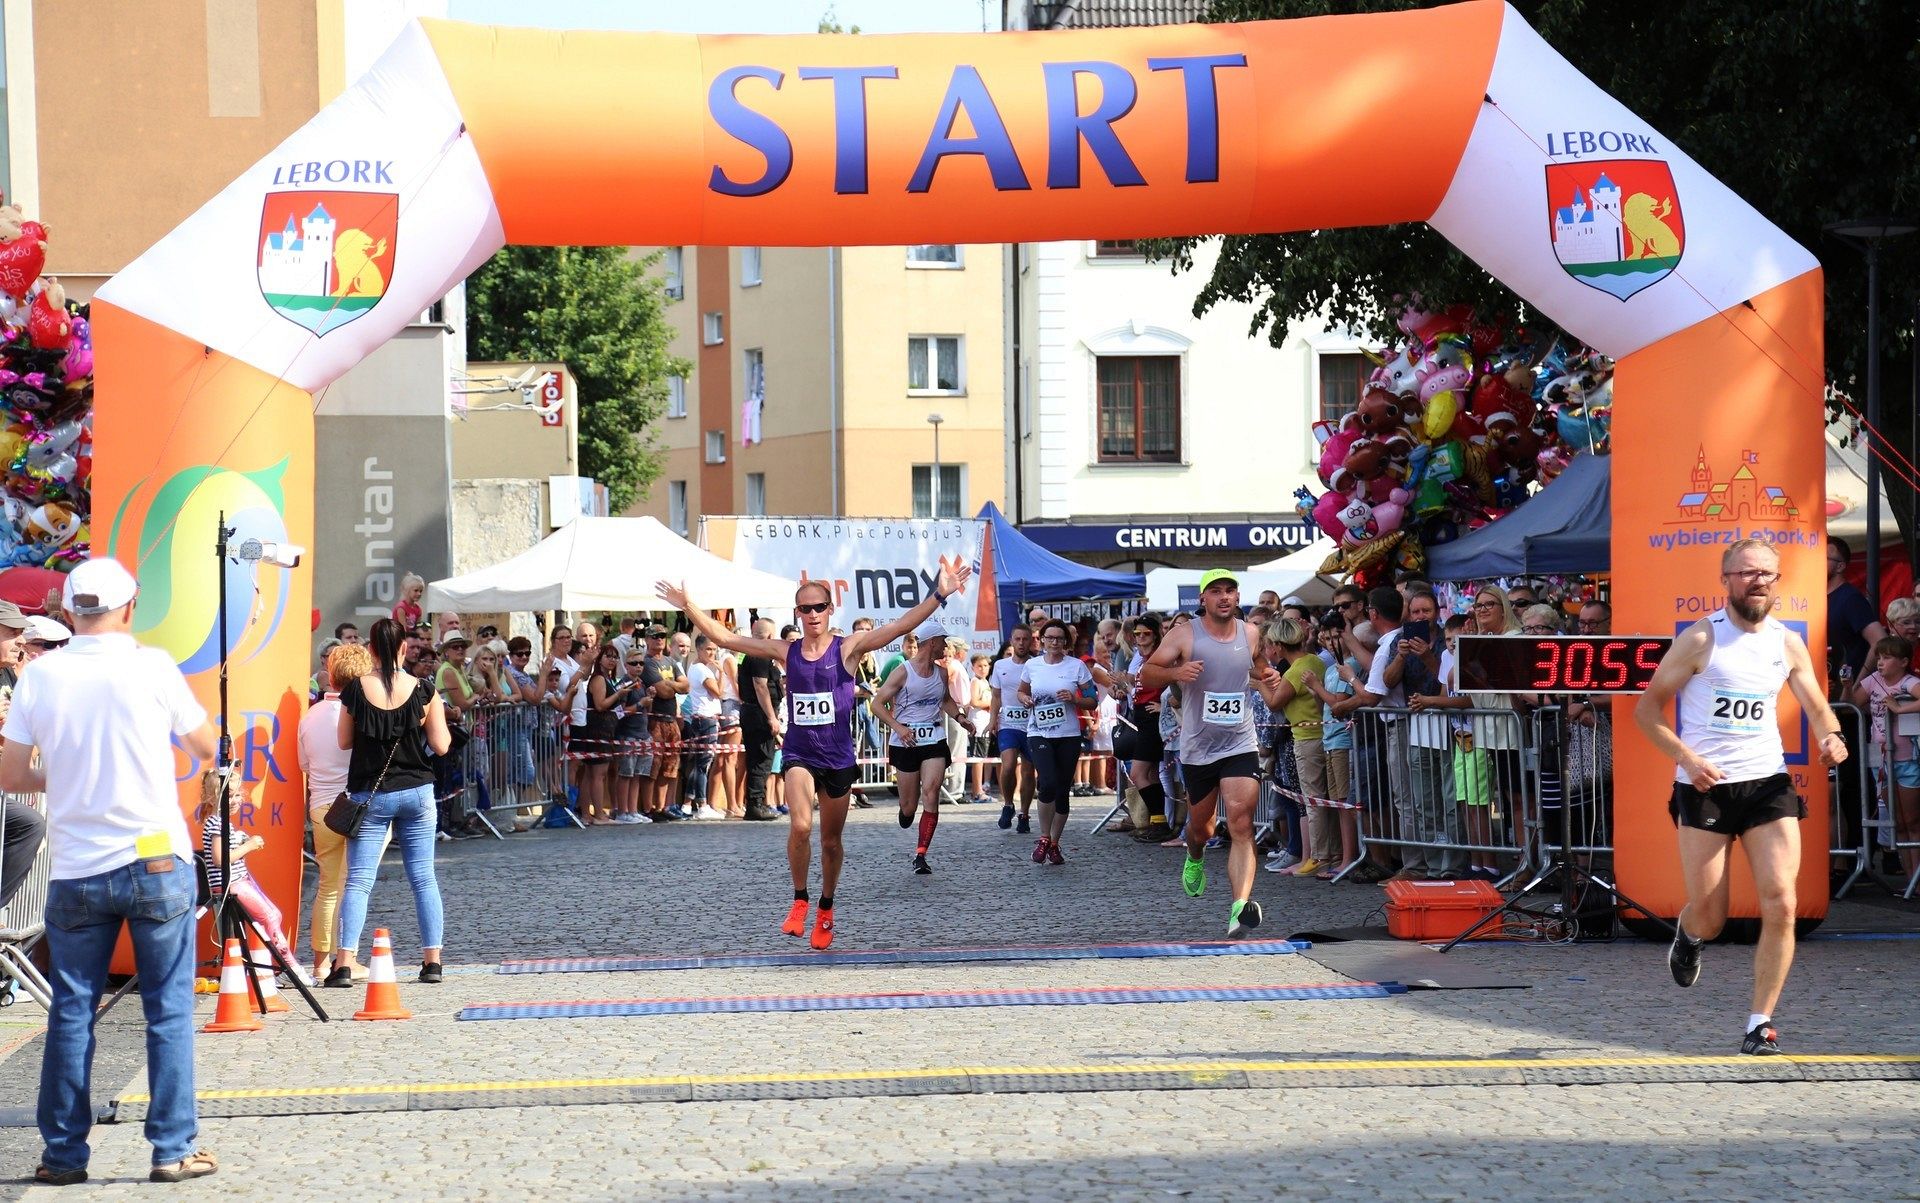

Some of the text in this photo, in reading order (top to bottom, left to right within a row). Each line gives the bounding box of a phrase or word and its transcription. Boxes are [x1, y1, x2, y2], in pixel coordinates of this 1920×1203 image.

[707, 52, 1248, 198] START
[1545, 130, 1660, 160] LĘBORK
[272, 158, 396, 189] LĘBORK
[1115, 527, 1228, 548] CENTRUM
[795, 700, 831, 716] 210
[1006, 709, 1029, 720] 436
[1037, 706, 1065, 721] 358
[1207, 699, 1241, 715] 343
[1713, 697, 1765, 721] 206
